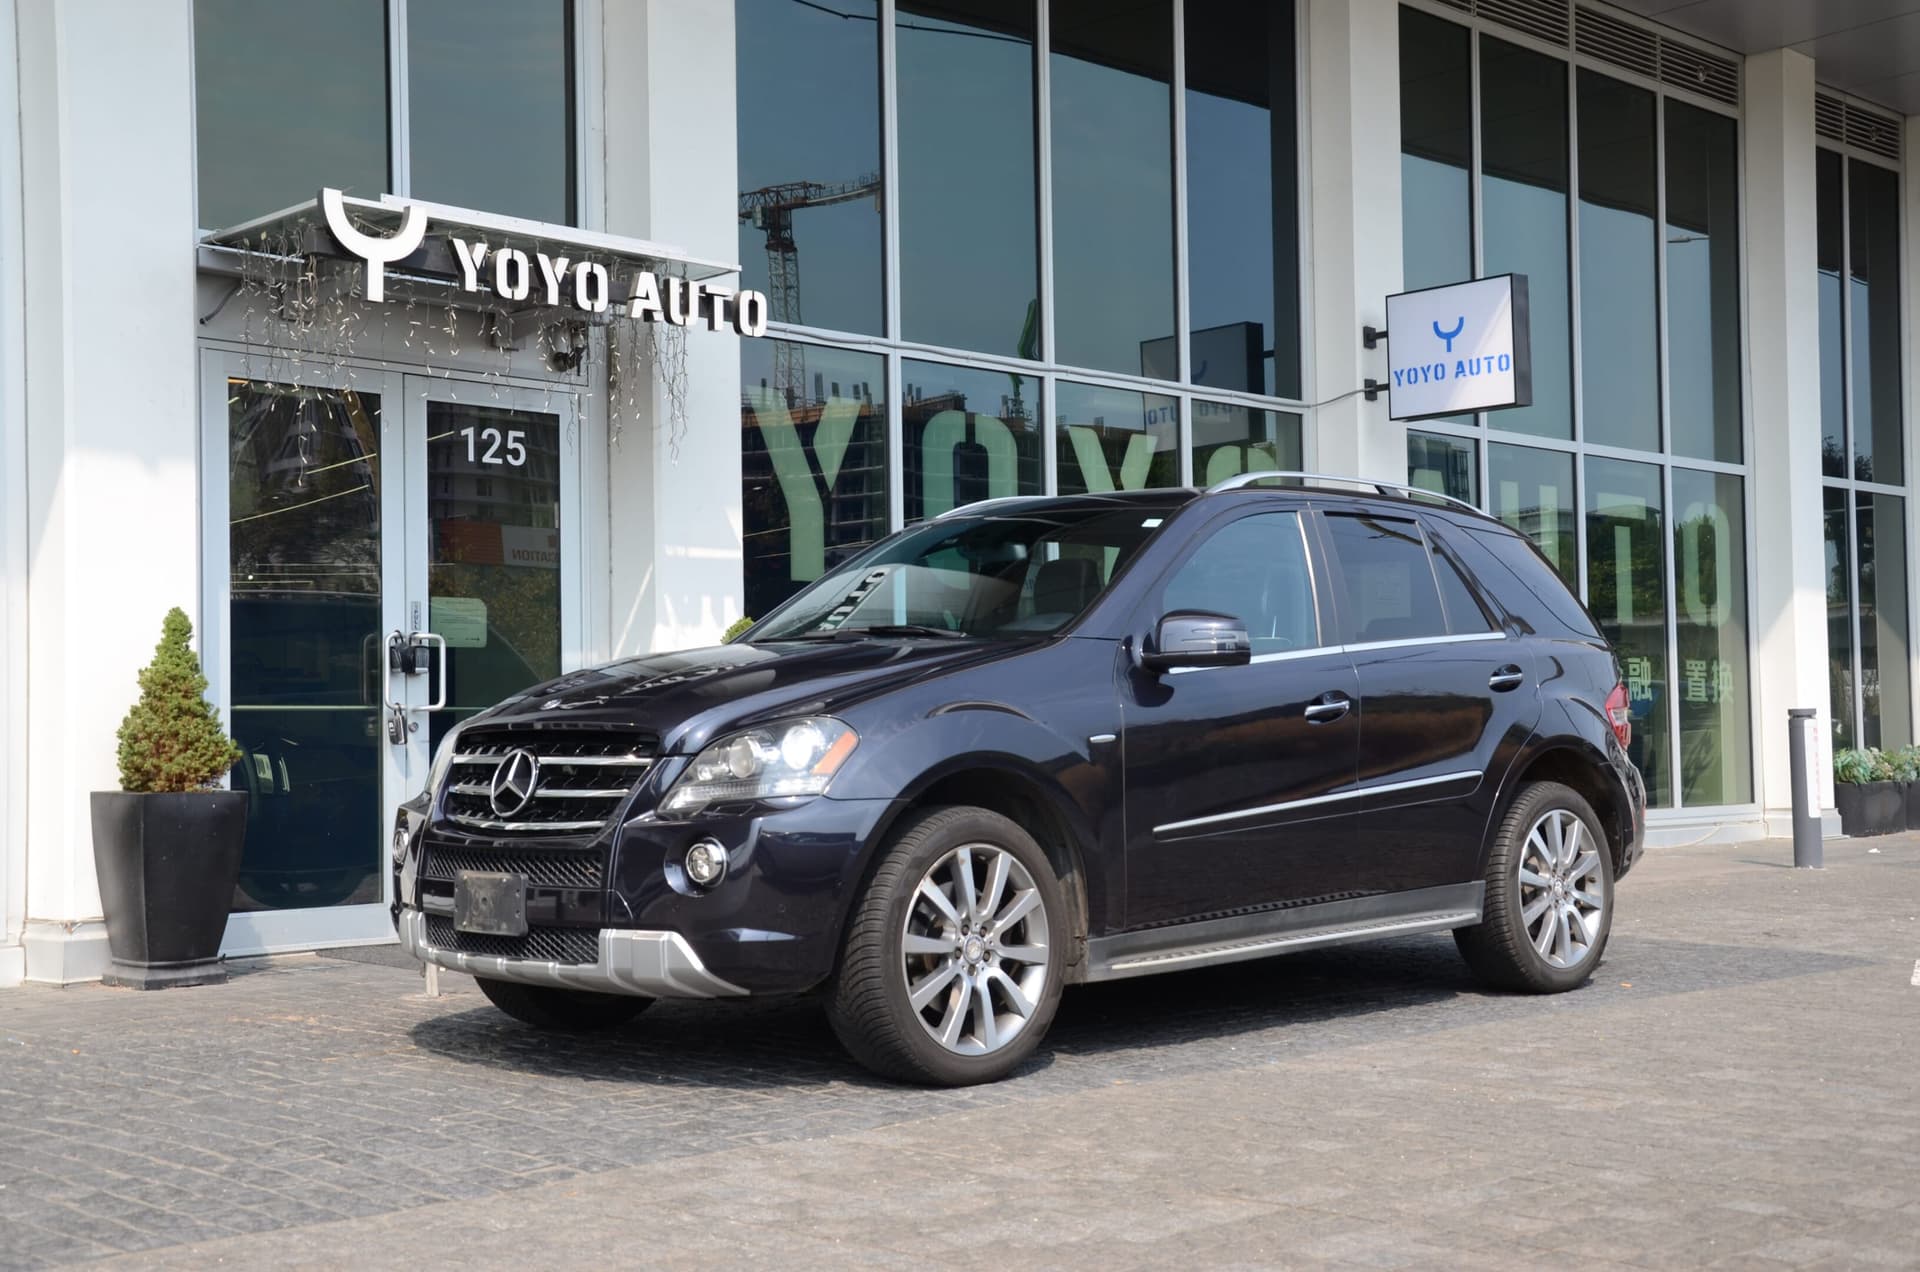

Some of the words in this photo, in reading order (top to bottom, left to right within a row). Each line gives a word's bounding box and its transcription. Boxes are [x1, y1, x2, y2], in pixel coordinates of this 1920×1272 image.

[451, 237, 609, 313] YOYO
[626, 271, 767, 338] AUTO
[1393, 362, 1446, 388] YOYO
[1454, 353, 1511, 379] AUTO
[460, 427, 527, 467] 125
[750, 385, 1281, 591] YOY
[1622, 656, 1653, 701] 融
[1685, 659, 1734, 703] 置换
